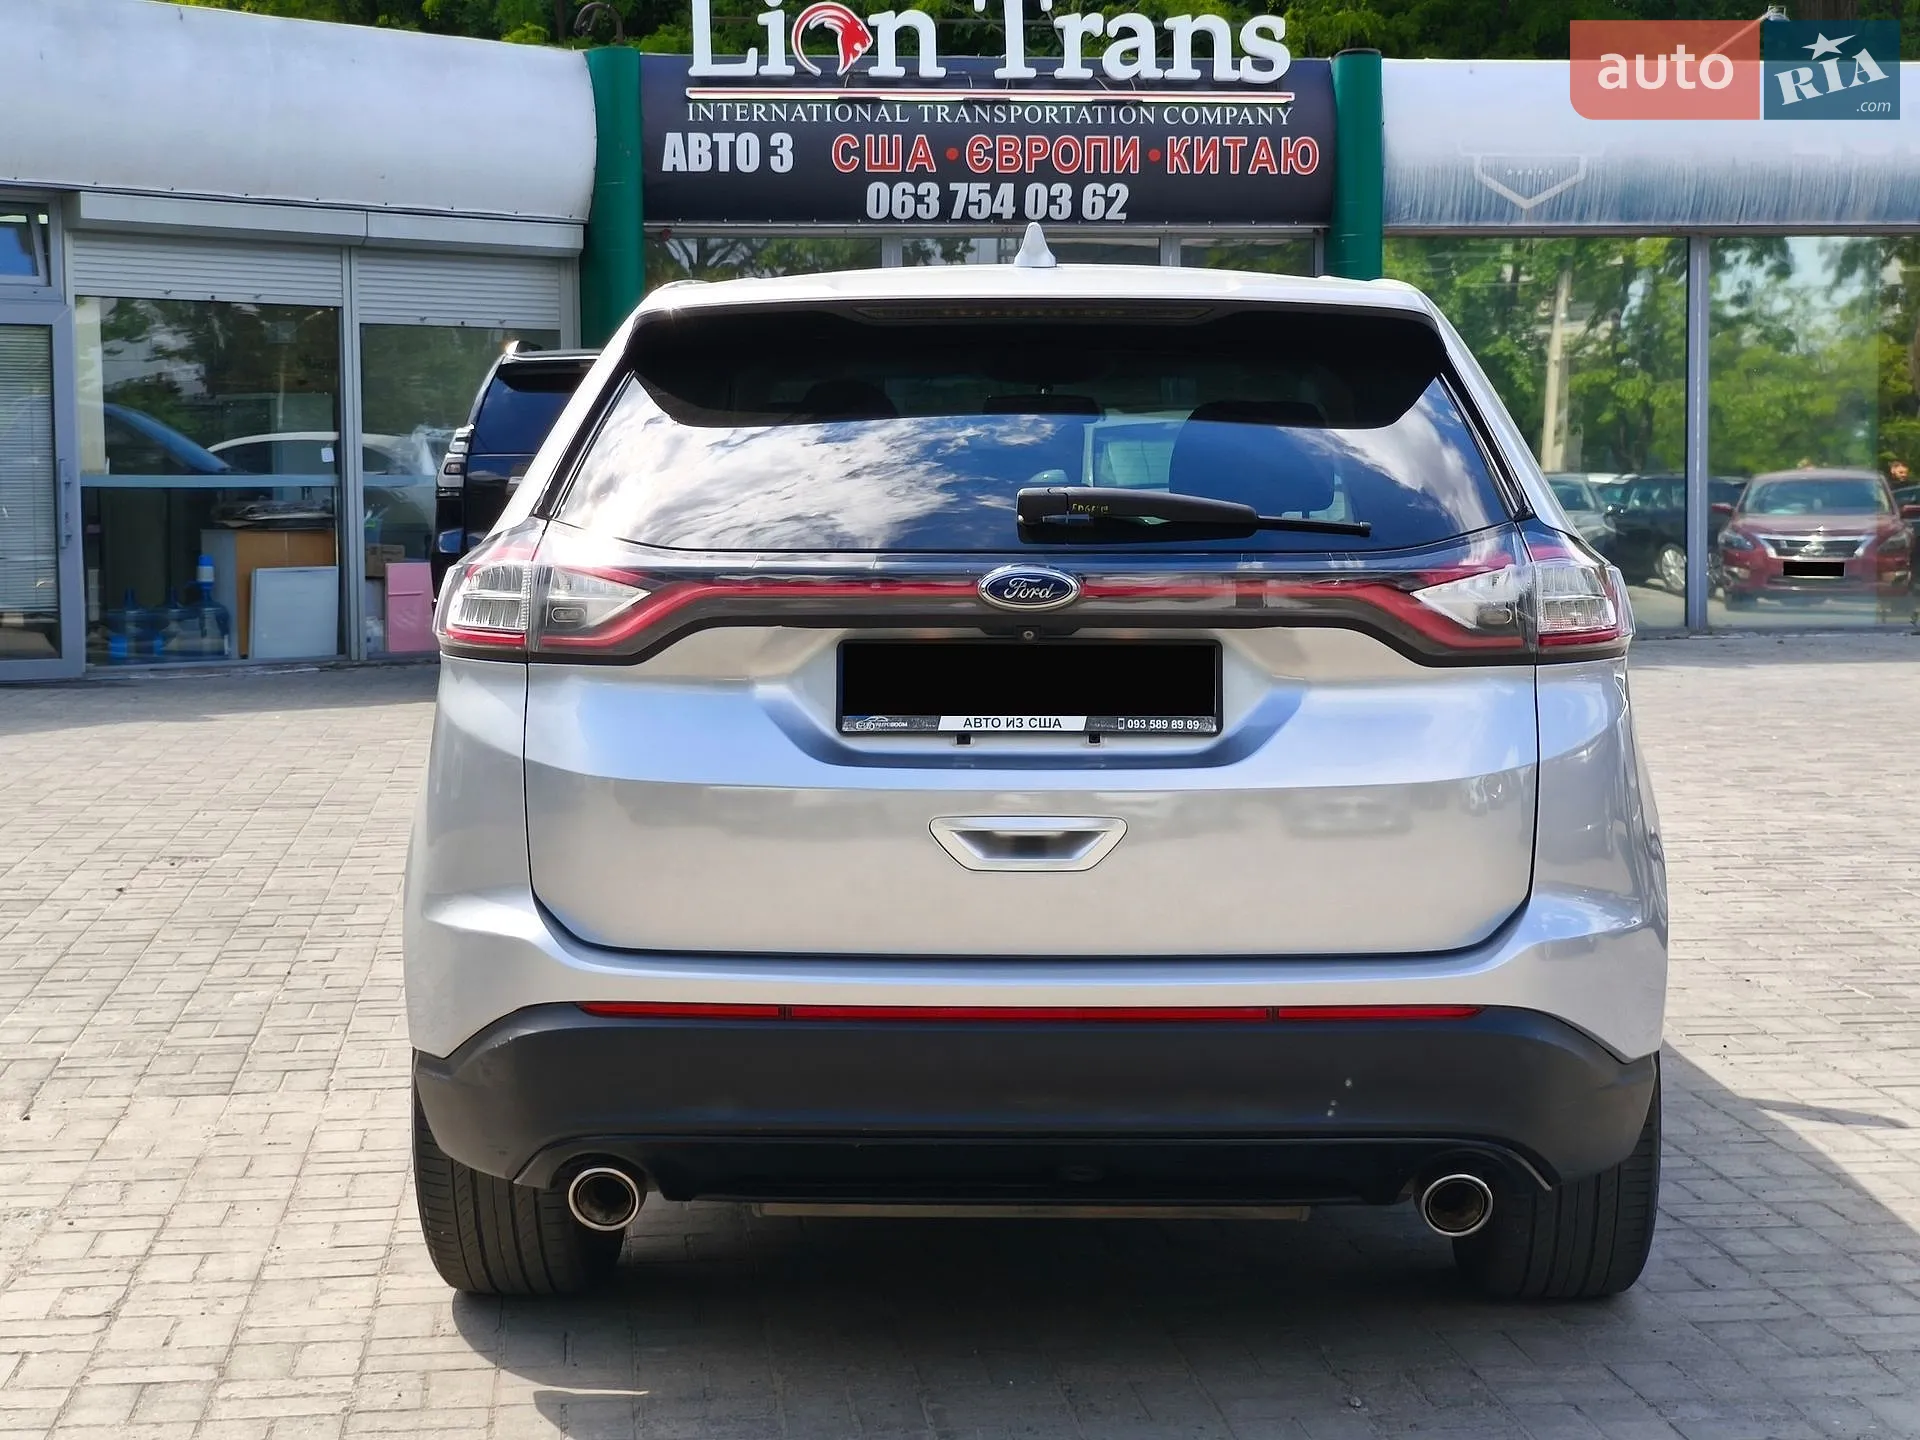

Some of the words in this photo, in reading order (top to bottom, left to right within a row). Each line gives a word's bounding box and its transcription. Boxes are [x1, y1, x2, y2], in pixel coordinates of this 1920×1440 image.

[973, 0, 1291, 84] Trans
[687, 103, 910, 123] INTERNATIONAL
[918, 104, 1155, 125] TRANSPORTATION
[1163, 105, 1293, 126] COMPANY
[661, 131, 760, 173] АВТО
[831, 133, 937, 174] США
[965, 134, 1141, 175] ЄВРОПИ
[1165, 135, 1321, 177] КИТАЮ
[866, 181, 940, 220] 063
[949, 182, 1016, 221] 754
[1024, 182, 1073, 221] 03
[1081, 182, 1130, 221] 62
[1003, 577, 1060, 599] Ford
[963, 717, 1001, 728] АВТО
[1006, 717, 1024, 728] ИЗ
[1028, 717, 1062, 728] США
[1127, 719, 1146, 729] 093
[1149, 719, 1168, 729] 589
[1186, 720, 1200, 730] 89
